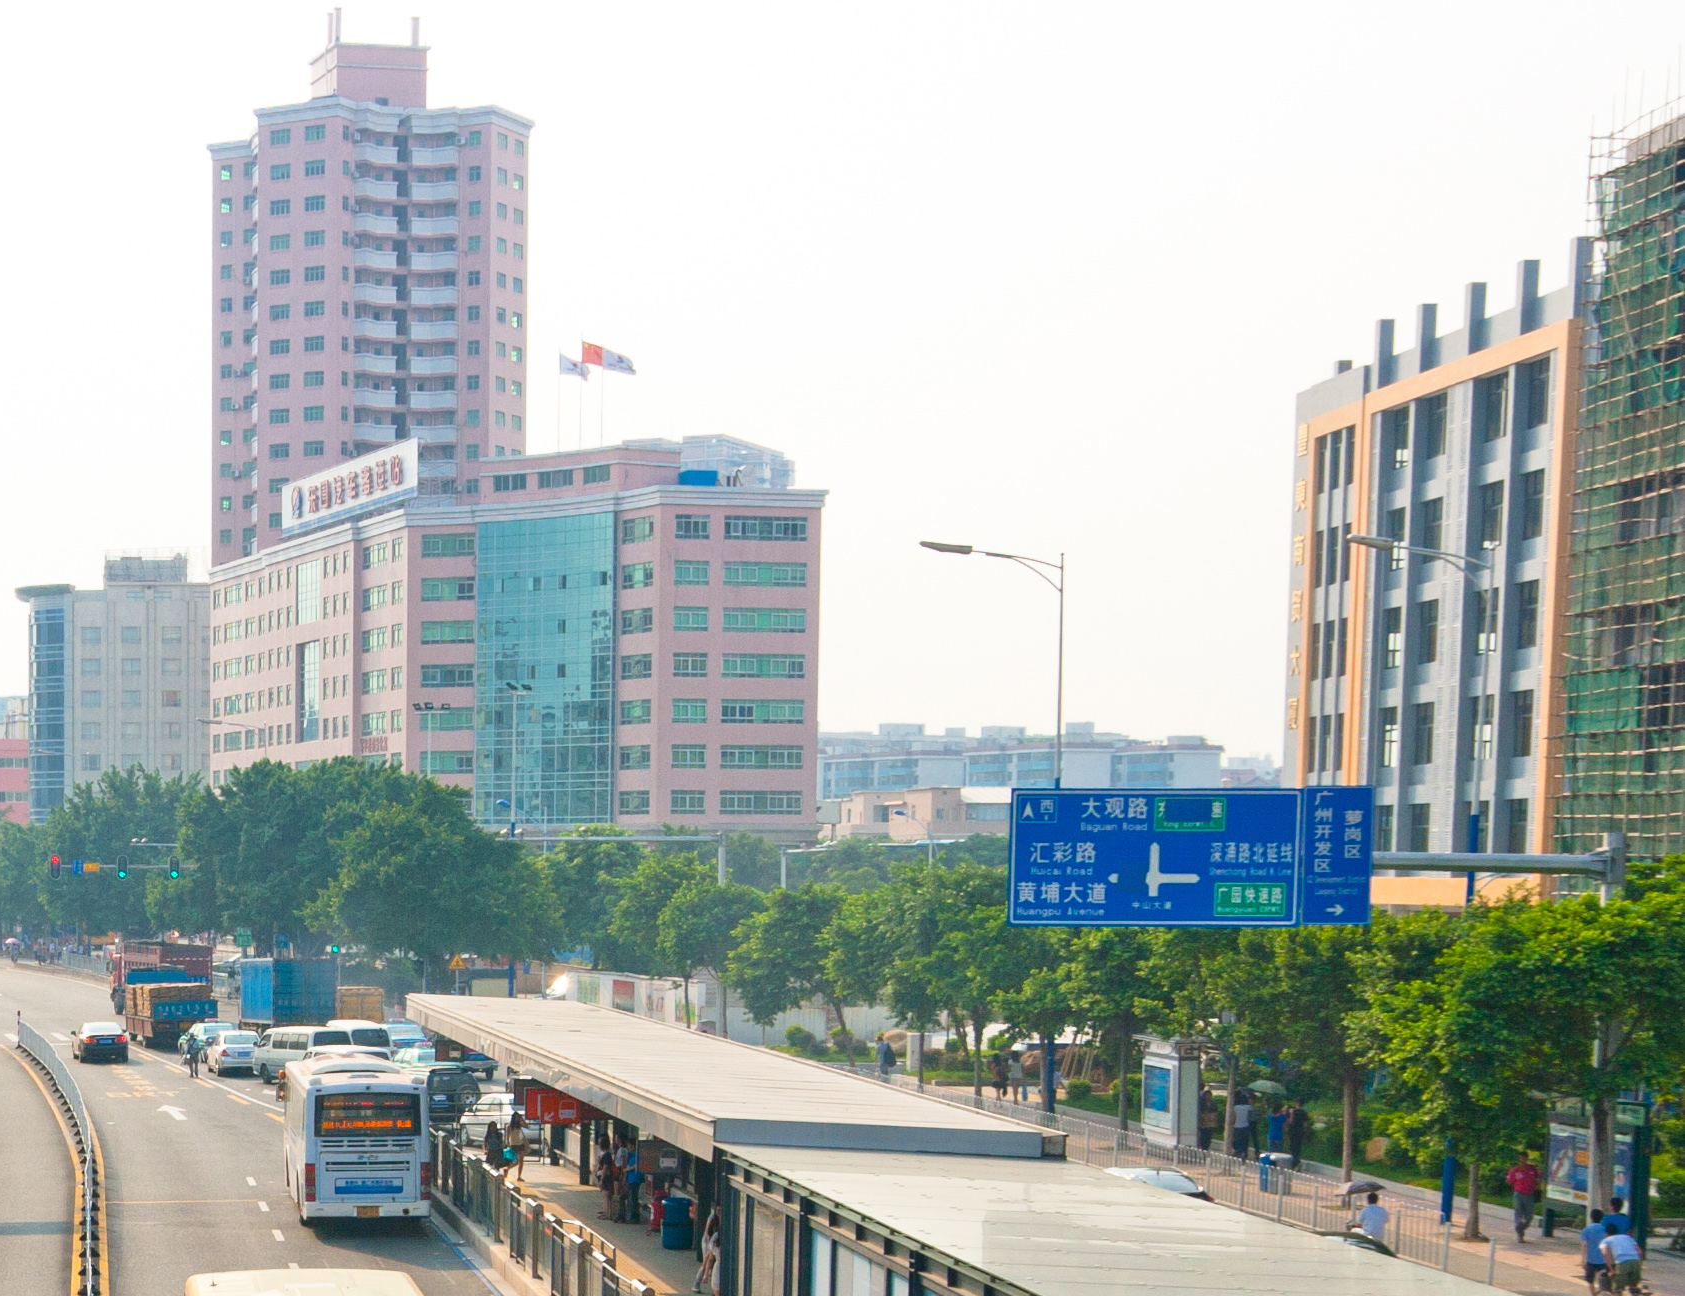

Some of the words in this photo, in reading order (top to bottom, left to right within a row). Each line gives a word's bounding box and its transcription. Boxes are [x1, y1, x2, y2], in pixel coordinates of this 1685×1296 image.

[1040, 799, 1054, 813] 西
[1081, 797, 1149, 819] 大观路
[1080, 822, 1118, 832] Daguan
[1122, 822, 1148, 831] Road
[1314, 790, 1334, 873] 广州开发区
[1343, 810, 1364, 858] 萝岗区
[1029, 841, 1096, 864] 汇彩路
[1067, 866, 1094, 875] Road
[1017, 882, 1107, 904] 黄埔大道
[1217, 886, 1282, 904] 广园快速路
[1017, 907, 1062, 917] Huangpu
[1067, 907, 1105, 916] Avenue
